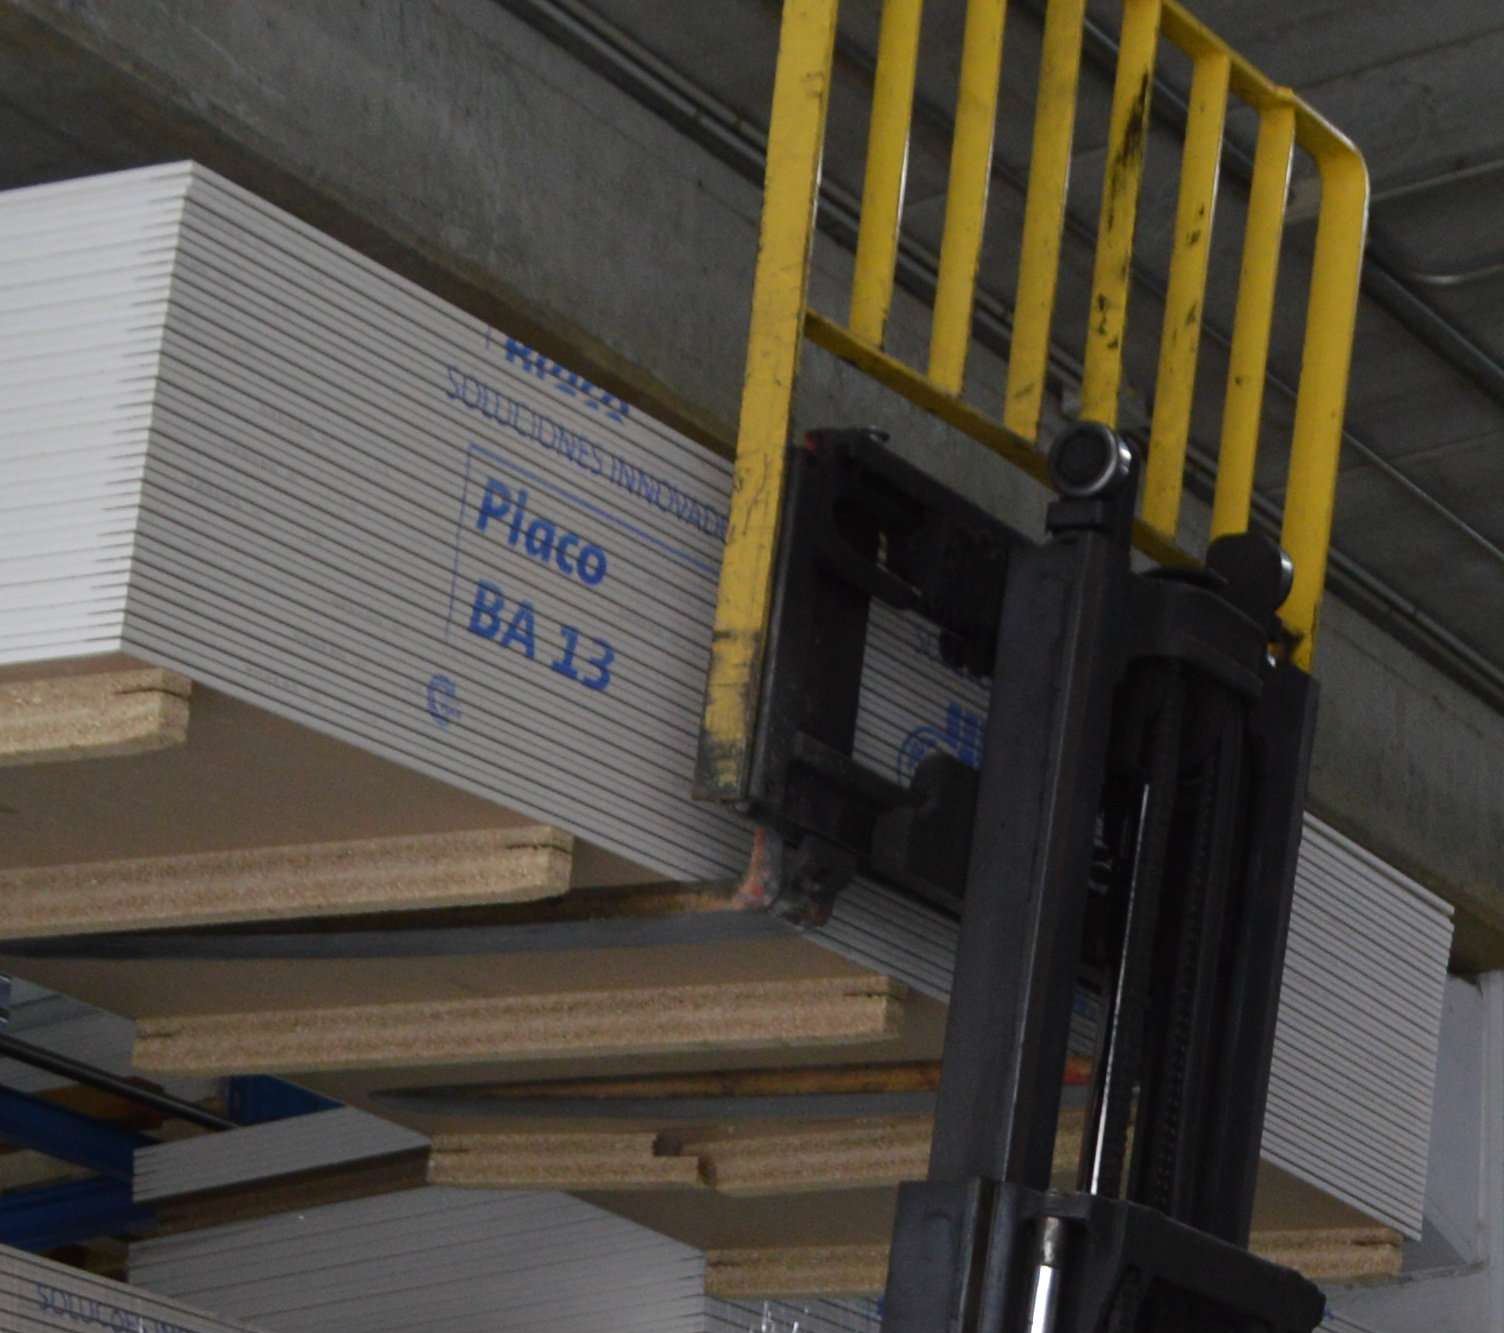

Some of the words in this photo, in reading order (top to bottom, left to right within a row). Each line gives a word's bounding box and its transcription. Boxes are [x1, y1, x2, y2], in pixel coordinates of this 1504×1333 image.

[447, 365, 602, 476] SOLUCIONES
[476, 478, 608, 587] Placo
[467, 579, 537, 661] BA
[550, 625, 617, 693] 13
